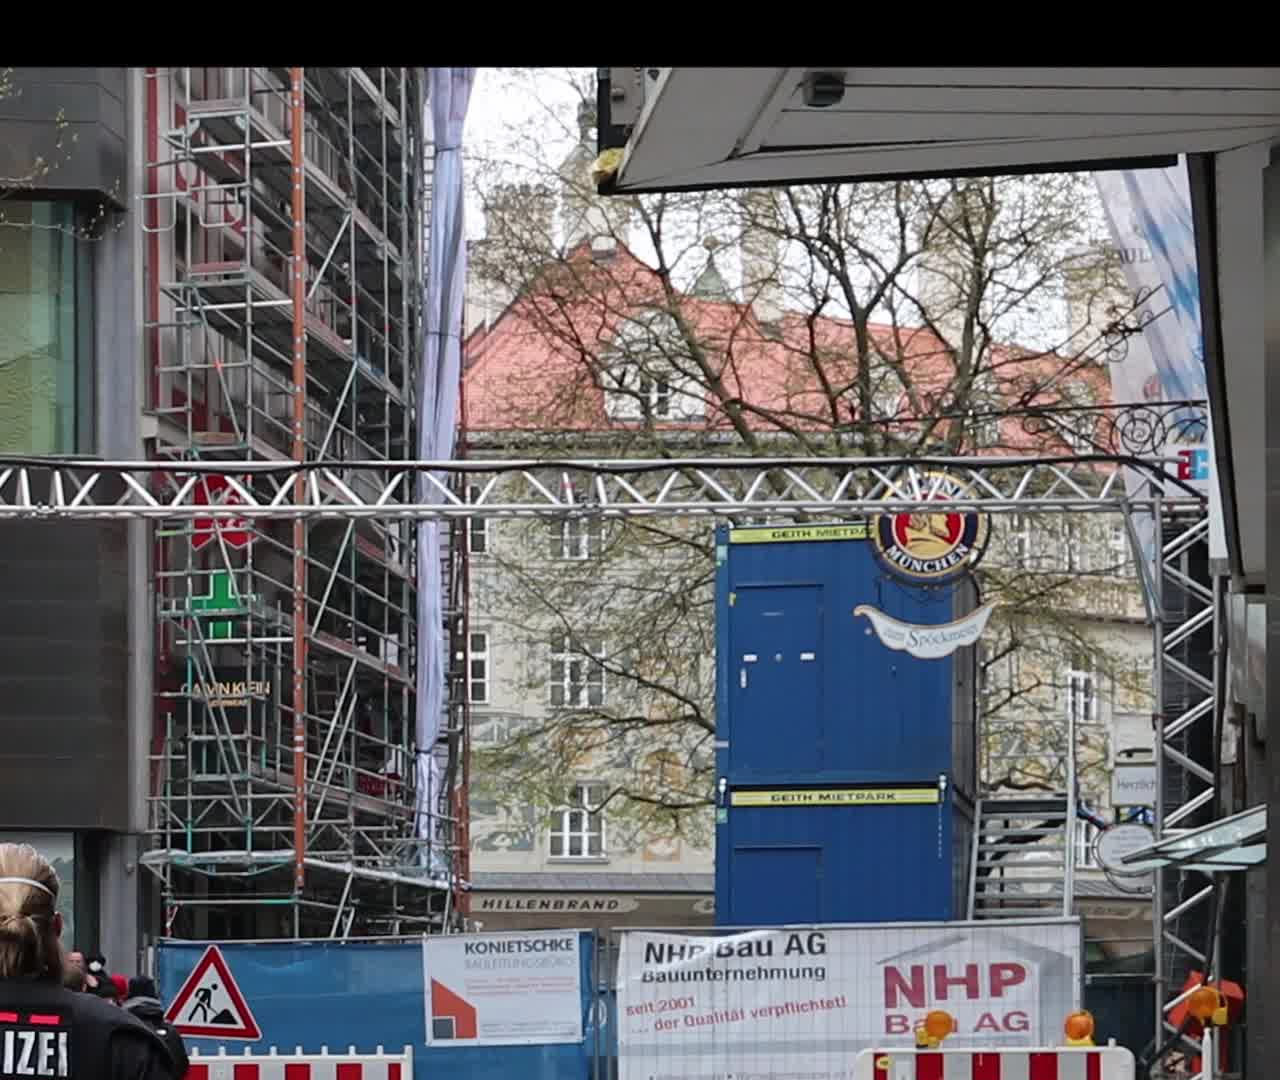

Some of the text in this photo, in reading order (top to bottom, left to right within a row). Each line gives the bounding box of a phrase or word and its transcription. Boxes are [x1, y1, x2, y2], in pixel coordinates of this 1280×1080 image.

[771, 530, 812, 540] GEITH
[771, 791, 897, 804] GEITH MIETPARK
[482, 898, 620, 911] HILLENBRAND
[464, 937, 575, 956] KONIETSCHKE
[784, 931, 827, 956] AG
[641, 965, 827, 984] Bauunternehmung
[883, 961, 1027, 1009] NHP
[625, 996, 695, 1017] seit 2001
[653, 1014, 679, 1032] der
[683, 1010, 745, 1029] Qualität
[974, 1011, 1031, 1033] AG
